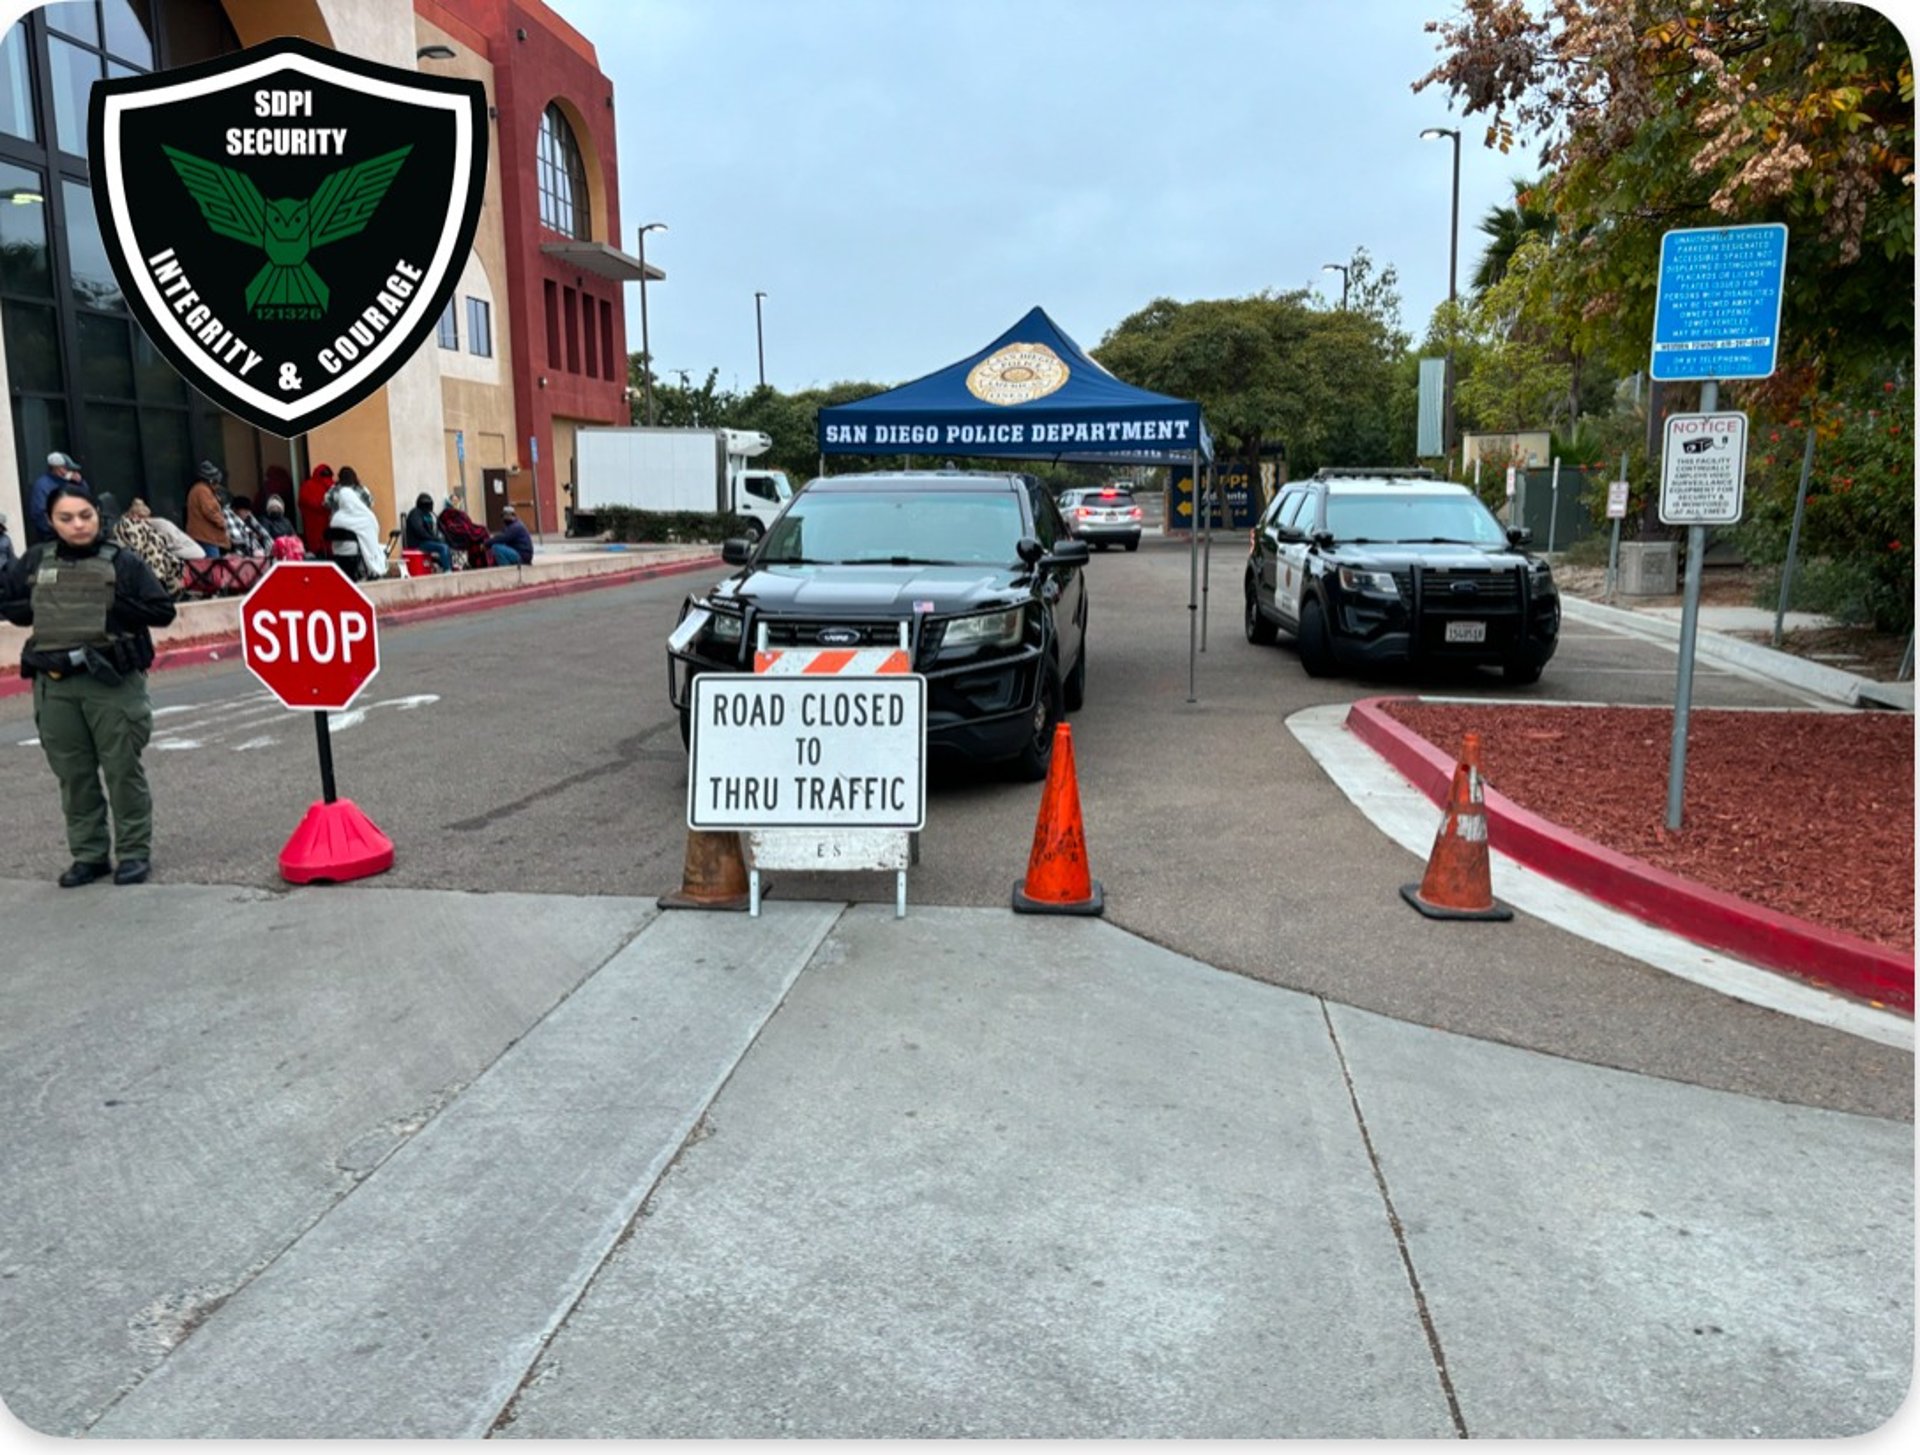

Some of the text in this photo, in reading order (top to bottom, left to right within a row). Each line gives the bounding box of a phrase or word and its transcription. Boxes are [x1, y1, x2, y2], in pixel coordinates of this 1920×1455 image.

[826, 420, 1190, 444] SAN DIEGO POLICE DEPARTMENT
[1673, 420, 1737, 434] NOTICE
[252, 609, 367, 664] STOP
[713, 693, 904, 727] ROAD CLOSED
[795, 736, 821, 766] TO
[709, 776, 905, 811] THRU TRAFFIC
